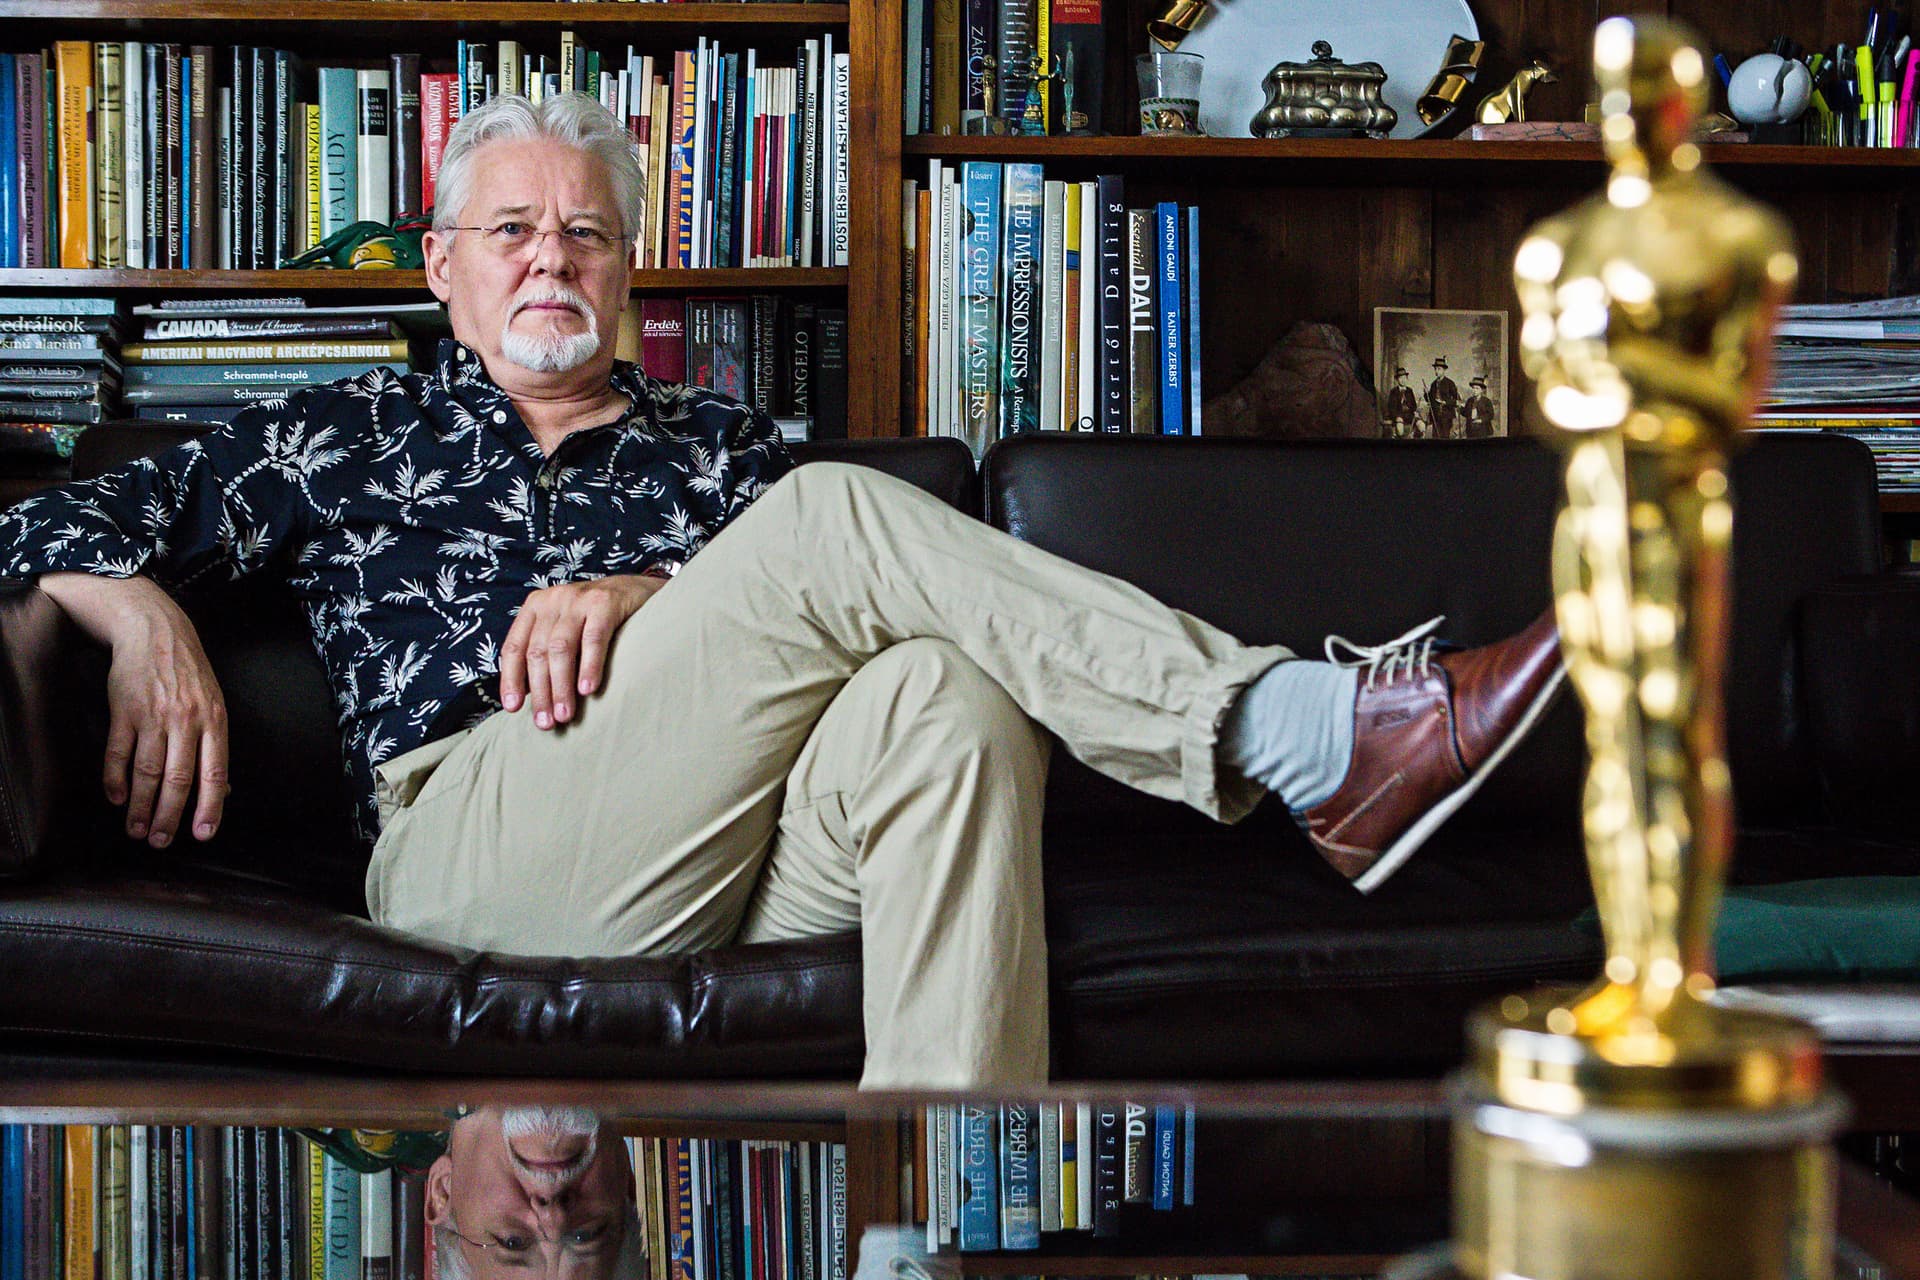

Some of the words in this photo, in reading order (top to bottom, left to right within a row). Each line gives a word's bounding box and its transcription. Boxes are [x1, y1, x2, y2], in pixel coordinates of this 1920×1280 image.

[564, 46, 573, 76] Puppen
[448, 82, 460, 118] MAGYAR
[308, 111, 320, 193] DIMENZIÓK
[328, 128, 346, 223] FALUDY
[805, 162, 814, 189] LOVAS
[837, 184, 847, 194] BY
[835, 195, 848, 252] POSTERS
[973, 197, 990, 242] THE
[1015, 190, 1032, 228] THE
[168, 230, 180, 257] Georg
[1133, 214, 1146, 271] Essential
[1166, 214, 1175, 248] ANTONI
[942, 241, 950, 270] TÖRÖK
[1167, 253, 1177, 282] GAUDÍ
[941, 277, 949, 300] GÉZA
[971, 247, 990, 318] GREAT
[1050, 250, 1061, 304] ALBRECHT
[941, 303, 949, 330] FEHÉR
[1010, 234, 1031, 378] IMPRESSIONISTS
[1130, 275, 1155, 332] DALÍ
[157, 320, 229, 338] CANADA
[644, 319, 682, 331] Erdély
[1167, 310, 1177, 348] RAINER
[141, 346, 203, 360] AMERIKAI
[206, 345, 273, 359] MAGYAROK
[276, 342, 391, 358] ARCKÉPCSARNOKA
[223, 370, 309, 382] Schrammel-napló
[794, 331, 809, 417] LANGELO
[969, 321, 987, 419] MASTERS
[1105, 325, 1121, 433] ürertől
[1168, 351, 1178, 388] ZERBST
[233, 388, 289, 400] Schrammel
[1014, 385, 1024, 393] A
